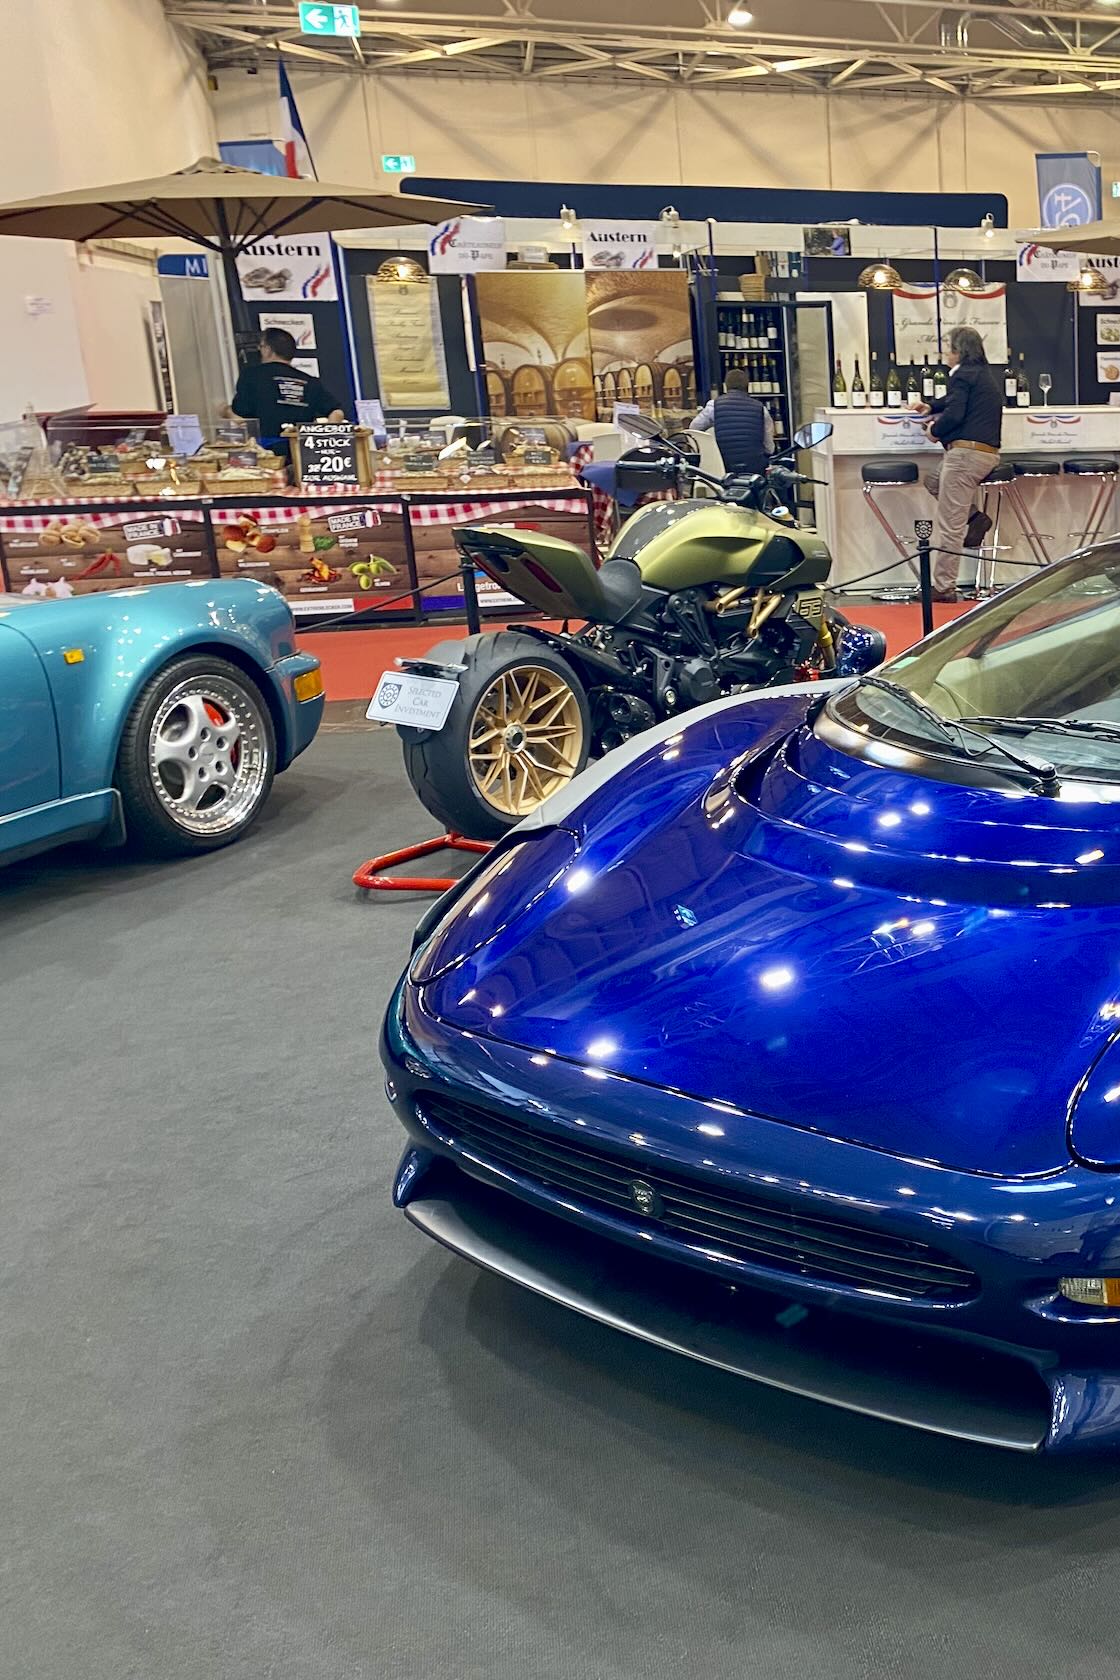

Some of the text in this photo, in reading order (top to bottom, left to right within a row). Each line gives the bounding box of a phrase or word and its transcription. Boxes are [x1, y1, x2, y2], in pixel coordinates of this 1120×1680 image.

[590, 231, 648, 243] Austern
[299, 424, 353, 433] ANGEBOT
[304, 435, 351, 449] 4 STÜCK
[408, 687, 442, 698] SELECTED
[412, 697, 429, 707] CAR
[394, 703, 442, 719] INVESTMENT
